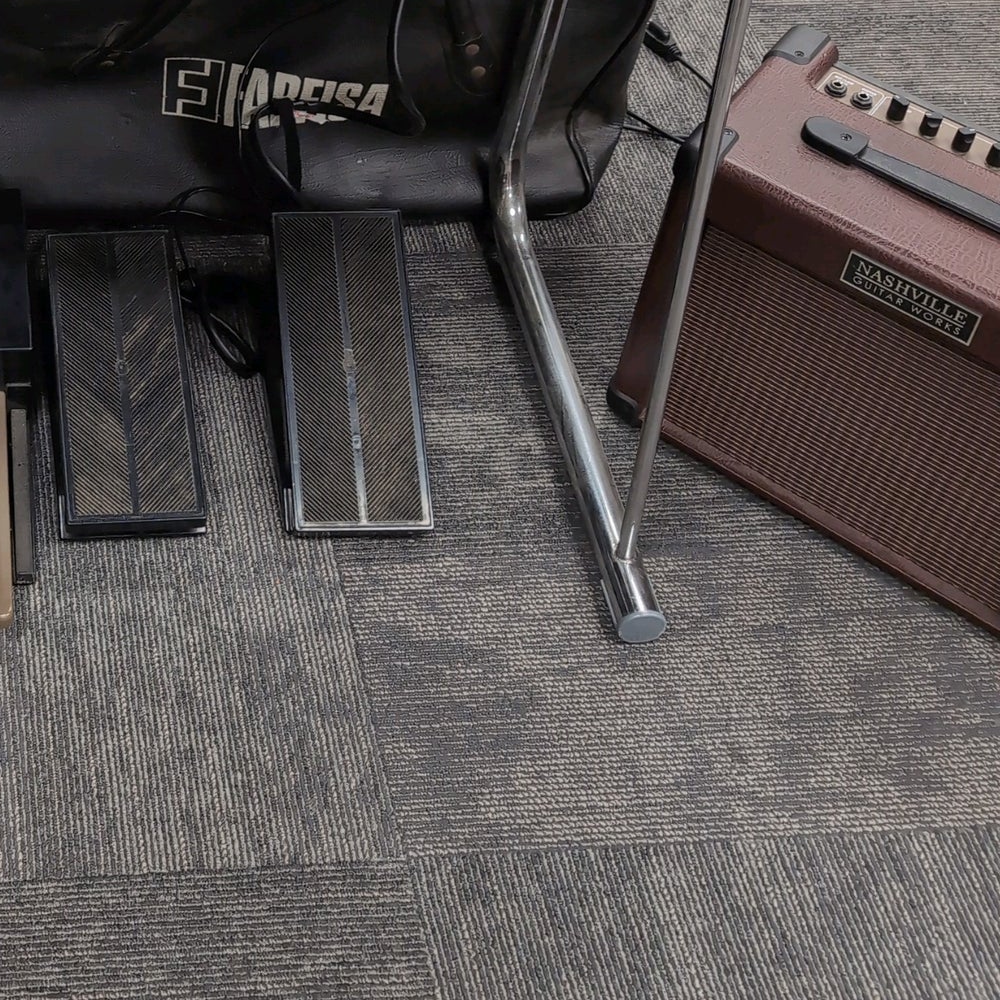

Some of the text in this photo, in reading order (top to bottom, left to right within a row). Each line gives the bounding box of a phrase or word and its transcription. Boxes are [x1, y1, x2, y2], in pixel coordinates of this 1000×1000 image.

[852, 276, 961, 336] GUITAR WORKS
[856, 261, 968, 325] NASHVILLE
